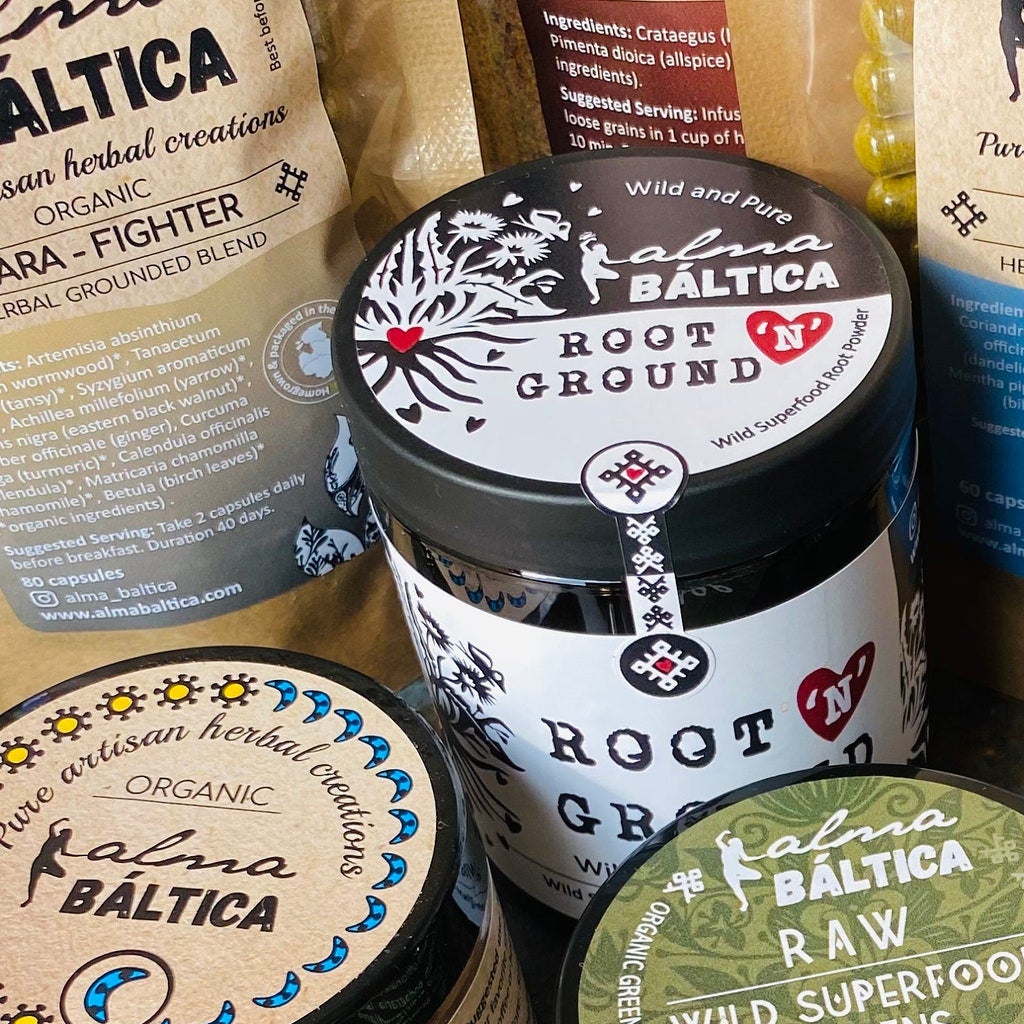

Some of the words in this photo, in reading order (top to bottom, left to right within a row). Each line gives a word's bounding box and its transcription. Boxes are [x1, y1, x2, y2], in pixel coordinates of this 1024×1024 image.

[543, 11, 632, 39] Ingredients:
[636, 26, 715, 46] Crataegus
[550, 34, 608, 58] Pimenta
[660, 51, 731, 70] (allspice)
[263, 38, 282, 73] Best
[64, 127, 156, 181] herbal
[165, 104, 289, 154] creations
[33, 178, 152, 226] ORGANIC
[90, 193, 243, 258] FIGHTER
[625, 180, 684, 197] Wild
[690, 186, 740, 205] and
[743, 194, 793, 226] Pure
[65, 255, 191, 303] GROUNDED
[200, 230, 268, 266] BLEND
[630, 228, 834, 263] alma
[630, 261, 840, 303] BÁLTICA
[27, 340, 108, 369] Artemisia
[110, 311, 202, 346] absinthium
[559, 321, 716, 358] ROOT
[516, 356, 762, 400] GROUND
[711, 426, 755, 450] Wild
[754, 379, 829, 434] Superfood
[823, 350, 853, 383] Root
[843, 308, 870, 351] Powder
[6, 535, 87, 556] Suggested
[91, 526, 156, 548] Serving:
[157, 513, 192, 534] Take
[198, 510, 207, 524] 2
[209, 487, 271, 521] capsules
[273, 473, 306, 496] daily
[11, 556, 64, 571] before
[67, 542, 144, 565] breakfast.
[148, 527, 216, 552] Duration
[217, 518, 236, 532] 40
[239, 504, 276, 529] days.
[21, 575, 43, 588] 80
[49, 566, 125, 588] capsules
[41, 582, 243, 622] www.almabaltica.com
[540, 708, 775, 772] ROOT
[60, 723, 190, 785] artisan
[198, 712, 331, 762] herbal
[309, 762, 376, 880] creations
[126, 775, 275, 807] ORGANIC
[87, 829, 296, 879] alma
[766, 808, 958, 858] alma
[773, 839, 974, 908] BÁLTICA
[60, 872, 279, 932] BÁLTICA
[628, 902, 672, 971] ORGANIC
[779, 906, 908, 968] RAW
